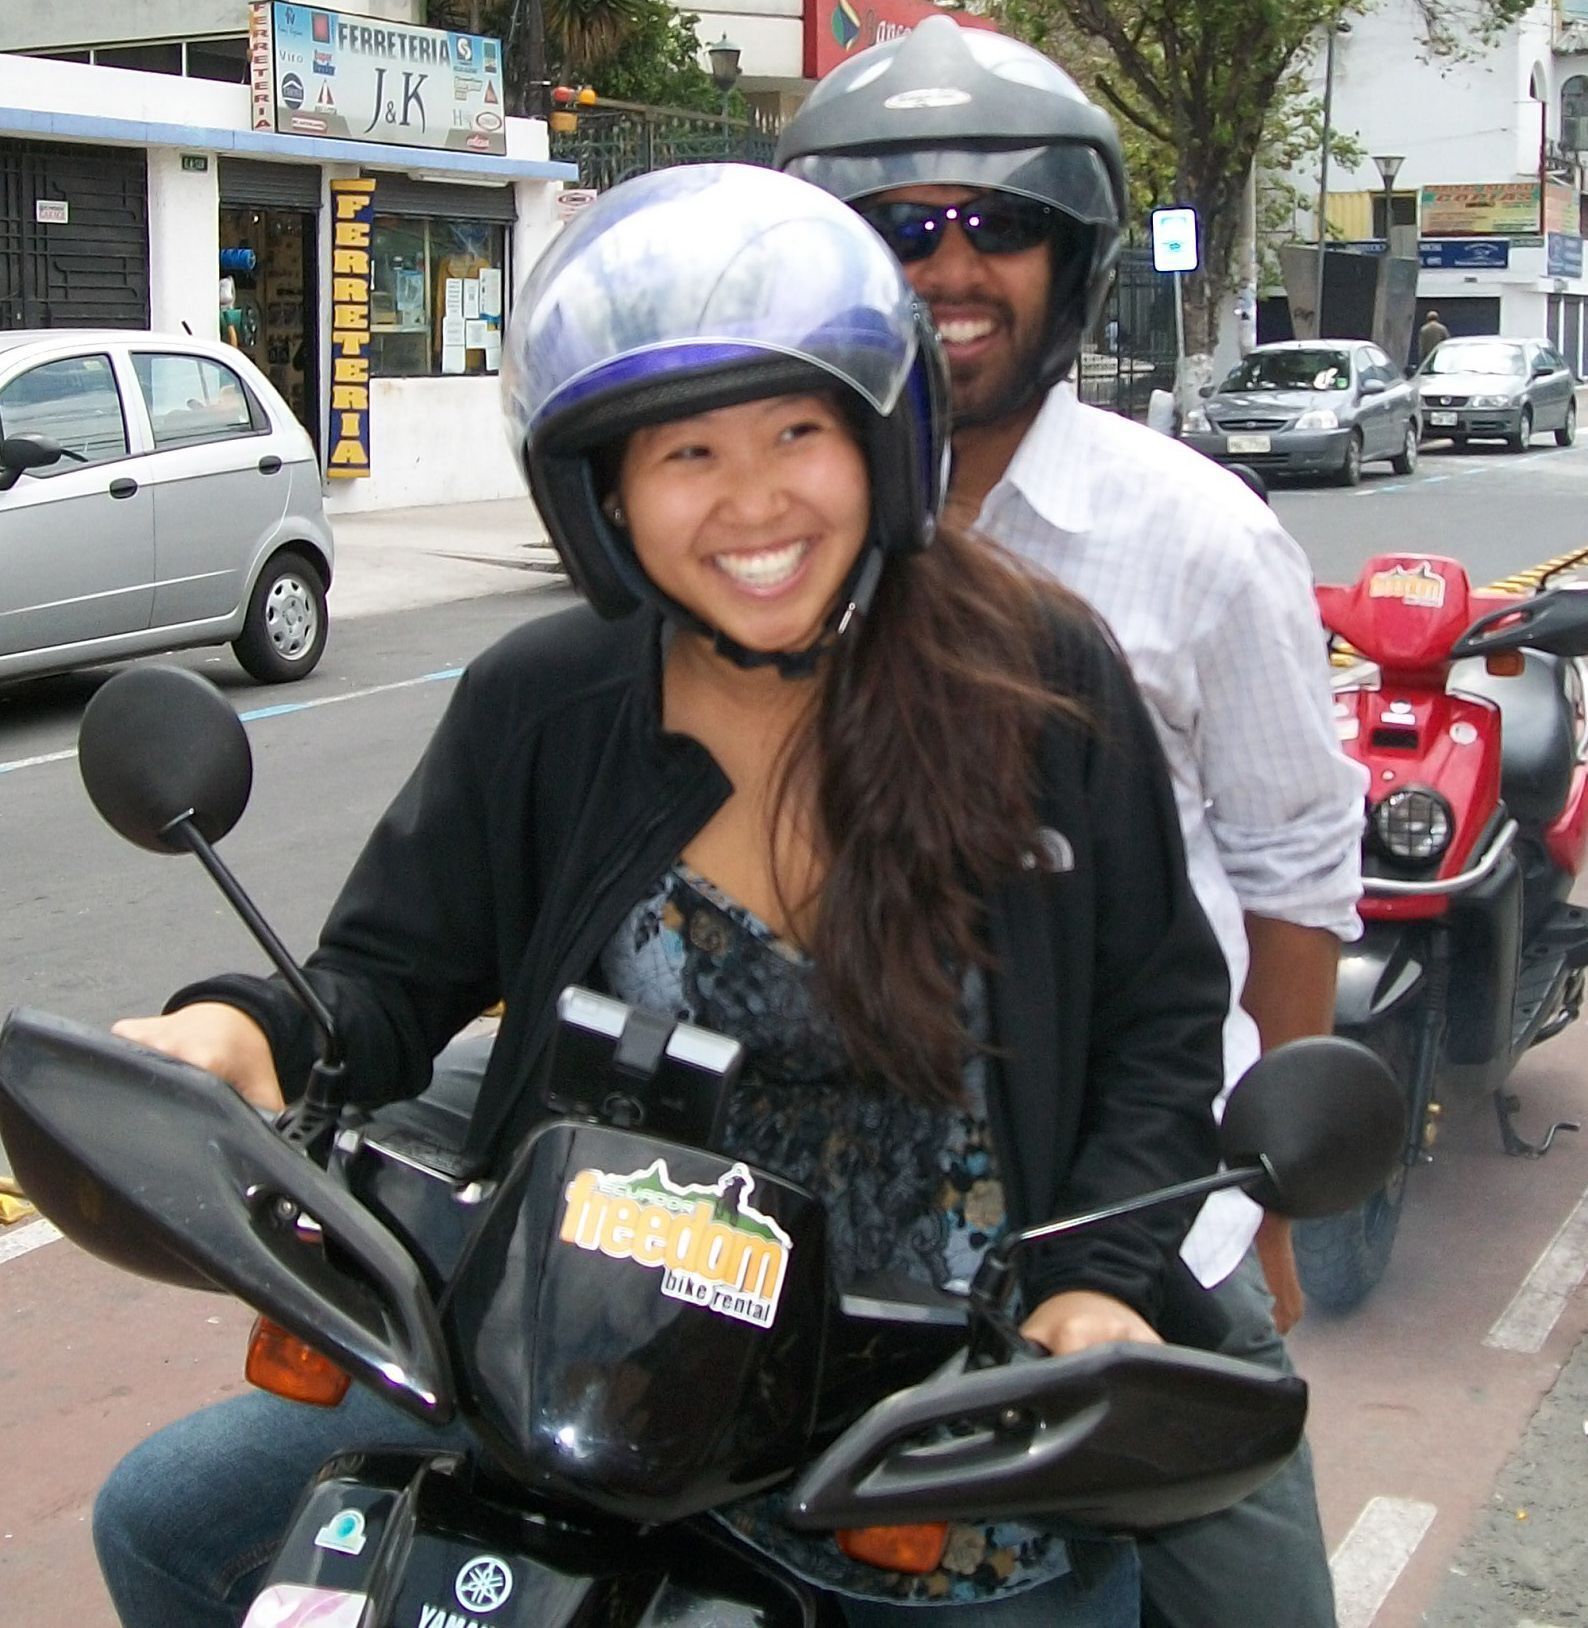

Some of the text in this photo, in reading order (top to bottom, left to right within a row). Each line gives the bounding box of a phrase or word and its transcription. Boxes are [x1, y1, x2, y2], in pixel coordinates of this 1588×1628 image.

[252, 3, 271, 129] FERRETERIA
[337, 22, 452, 66] FERRETERIA
[331, 194, 371, 464] FERRETERIA
[560, 1168, 784, 1300] freedom
[664, 1270, 772, 1323] bike rental
